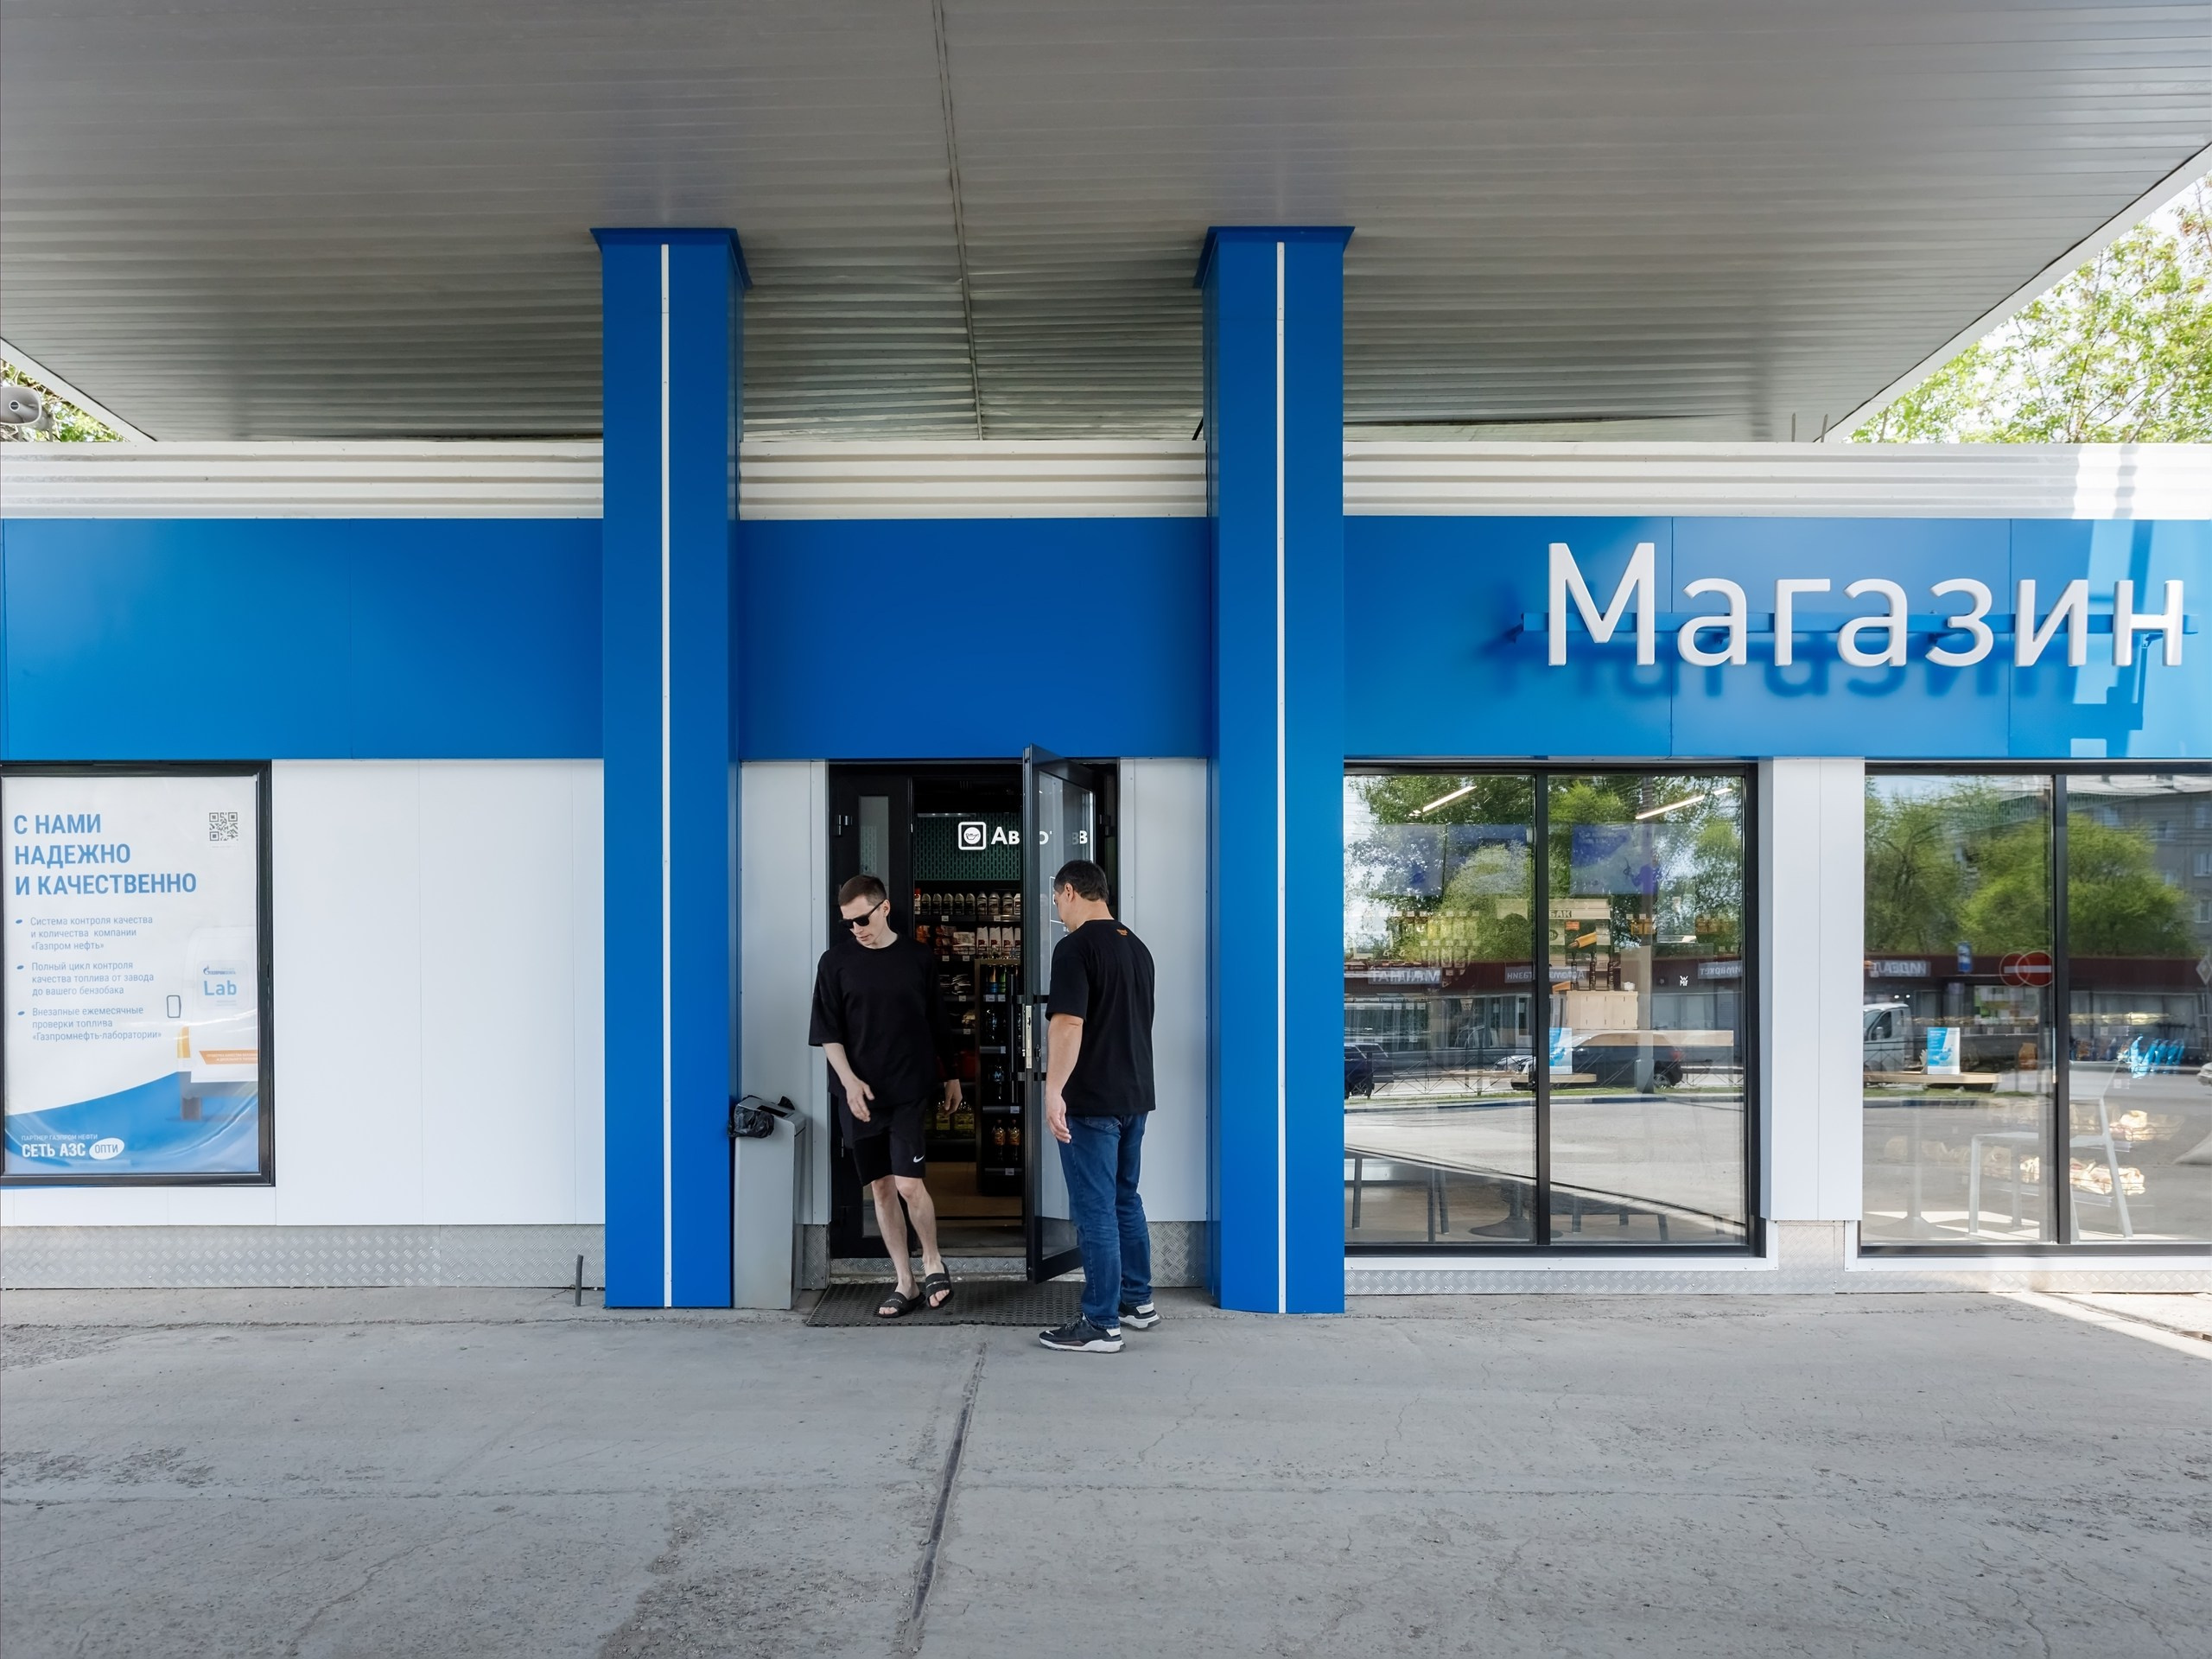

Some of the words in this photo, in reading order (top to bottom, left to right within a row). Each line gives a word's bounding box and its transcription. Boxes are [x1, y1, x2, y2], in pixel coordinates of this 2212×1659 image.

[1548, 542, 2183, 667] Магазин
[13, 815, 28, 835] С
[35, 814, 101, 835] НАМИ
[15, 843, 130, 868] НАДЕЖНО
[16, 876, 29, 895] И
[38, 873, 197, 895] КАЧЕСТВЕННО
[30, 917, 68, 926] Система
[70, 918, 111, 926] контроля
[38, 930, 89, 938] количества
[31, 941, 71, 951] «Газпром
[73, 940, 105, 951] нефть»
[32, 962, 67, 970] Полный
[69, 963, 91, 971] цикл
[92, 962, 133, 970] контроля
[124, 974, 155, 983] завода
[32, 988, 43, 997] до
[79, 985, 124, 995] бензобака
[204, 980, 238, 995] Lab
[32, 1007, 79, 1016] Внезапные
[82, 1007, 144, 1015] ежемесячные
[32, 1021, 74, 1030] проверки
[32, 1031, 162, 1042] «Газпромнефть-лаборатории»
[22, 1143, 56, 1158] СЕТЬ
[60, 1142, 86, 1157] АЗС
[94, 1144, 119, 1154] ОПТИ
